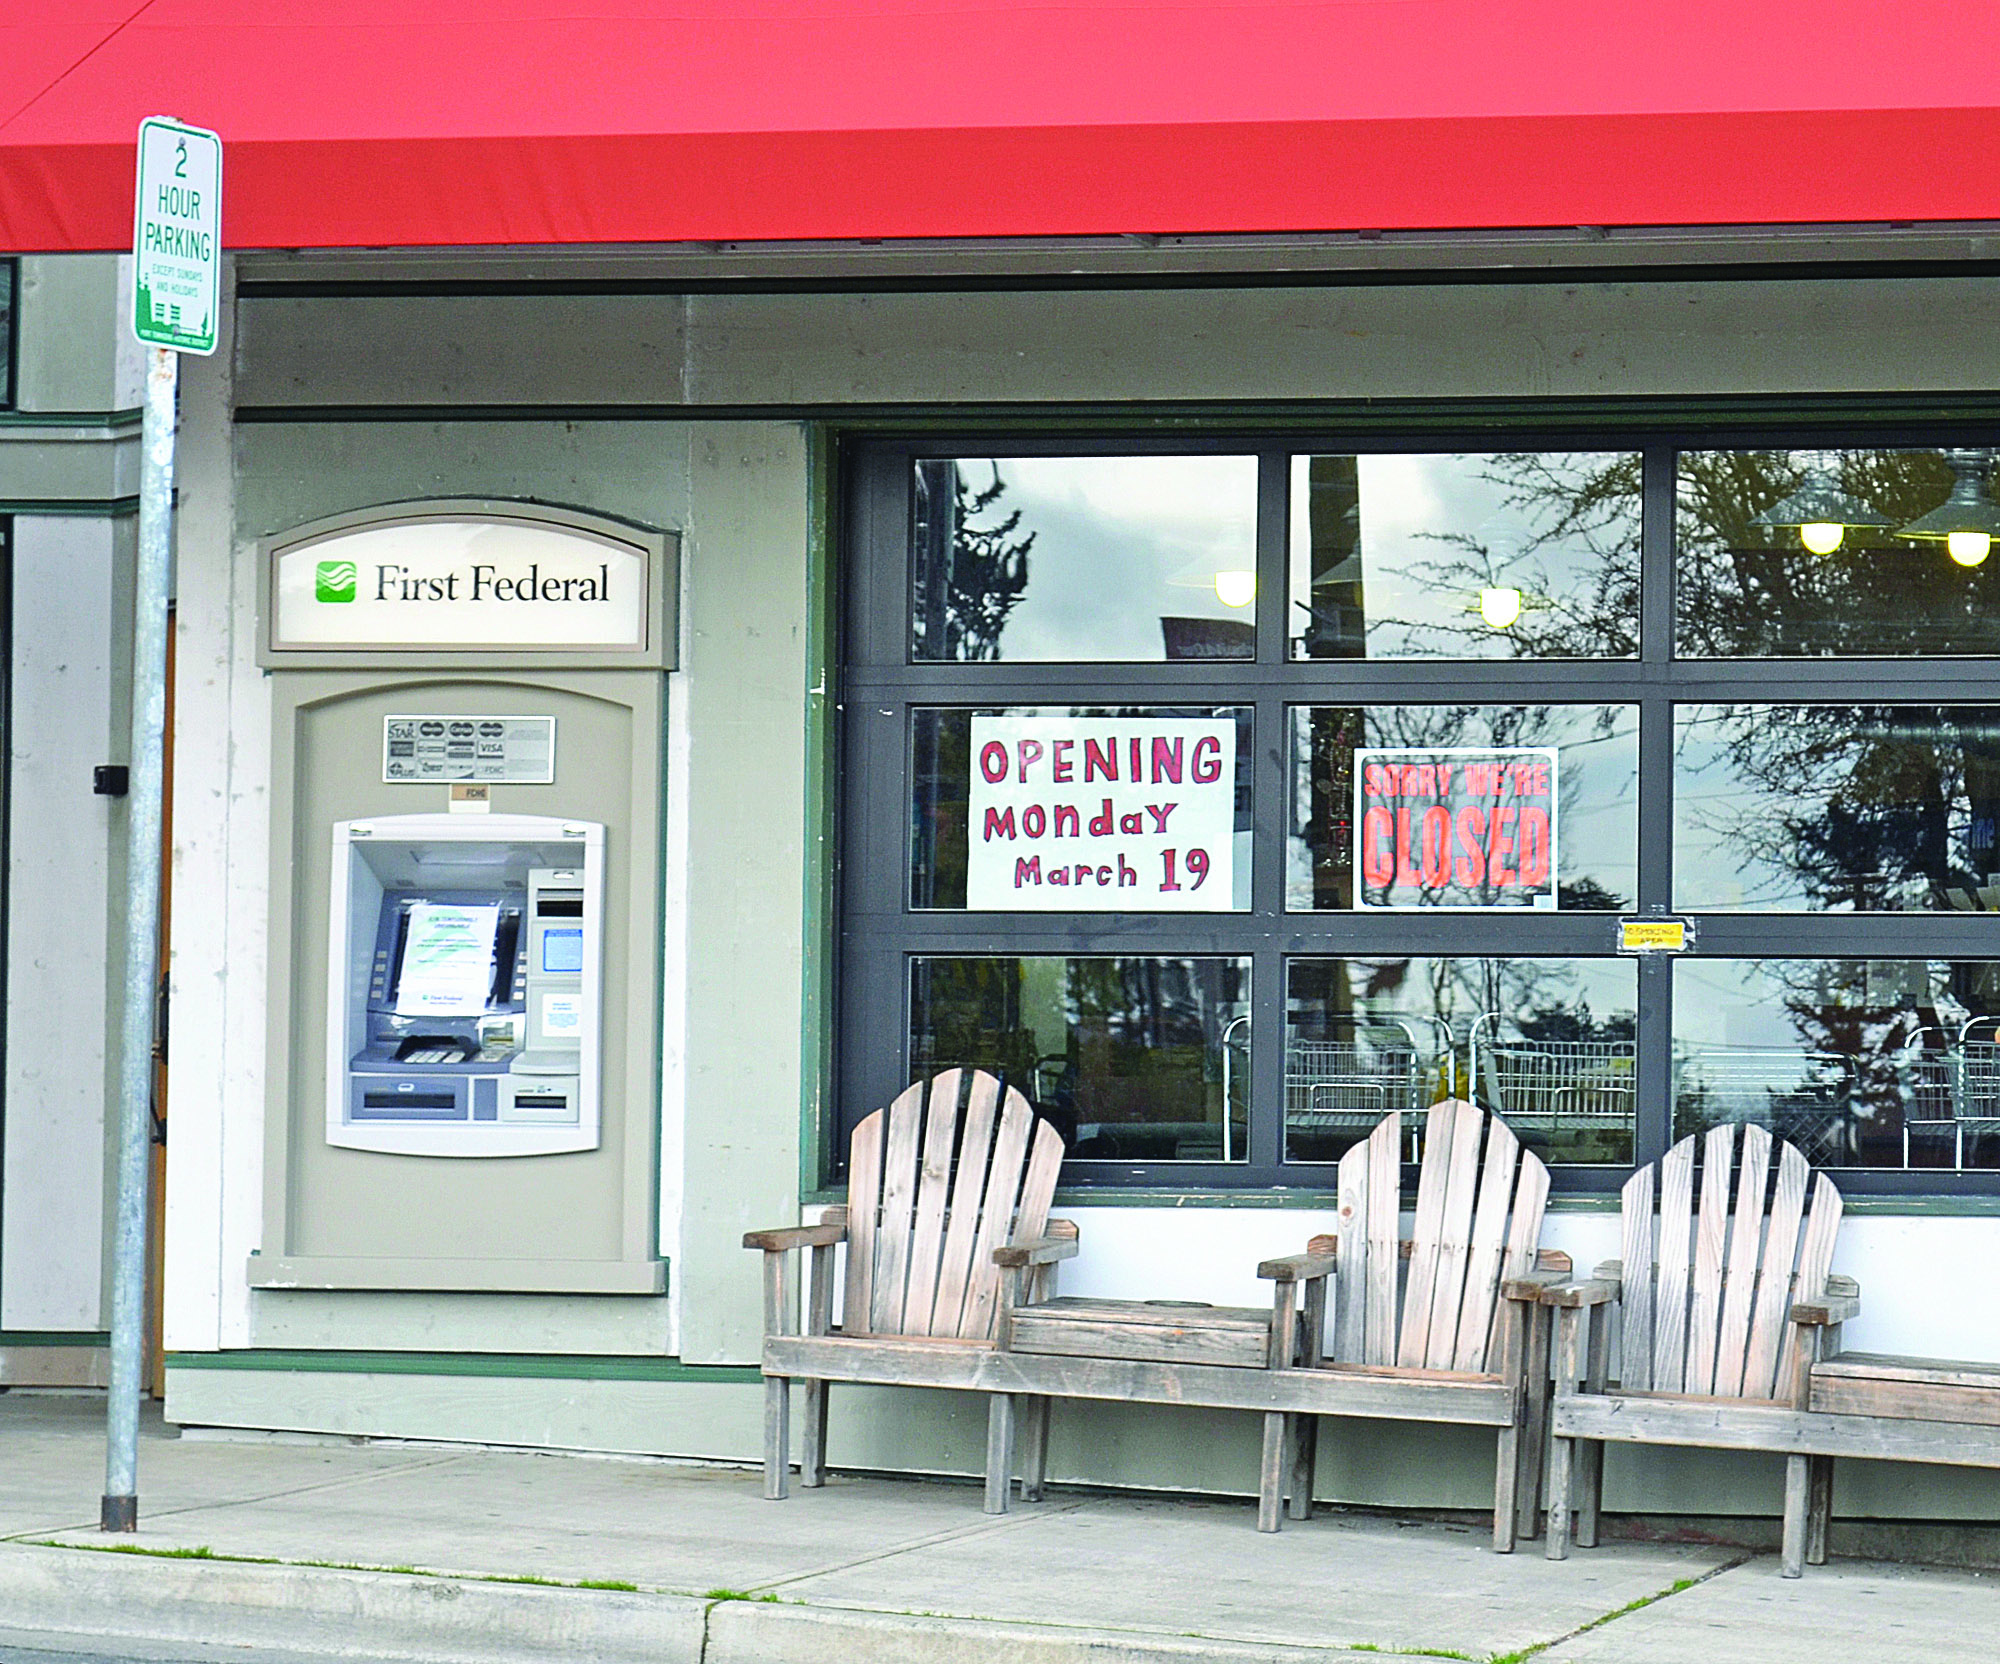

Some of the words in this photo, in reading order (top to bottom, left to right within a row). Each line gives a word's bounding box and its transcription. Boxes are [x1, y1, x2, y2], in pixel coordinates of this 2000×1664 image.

[175, 146, 187, 178] 2
[158, 183, 200, 220] HOUR
[145, 222, 210, 262] PARKING
[152, 263, 175, 277] EXCEPT
[374, 564, 459, 601] First
[469, 563, 610, 602] Federal
[480, 743, 503, 753] VISA
[979, 736, 1222, 785] OPENING
[1364, 763, 1453, 798] SORRY
[1464, 763, 1550, 797] WE'RE
[1363, 804, 1550, 889] CLOSED
[1014, 853, 1137, 888] March
[1159, 847, 1211, 892] 19
